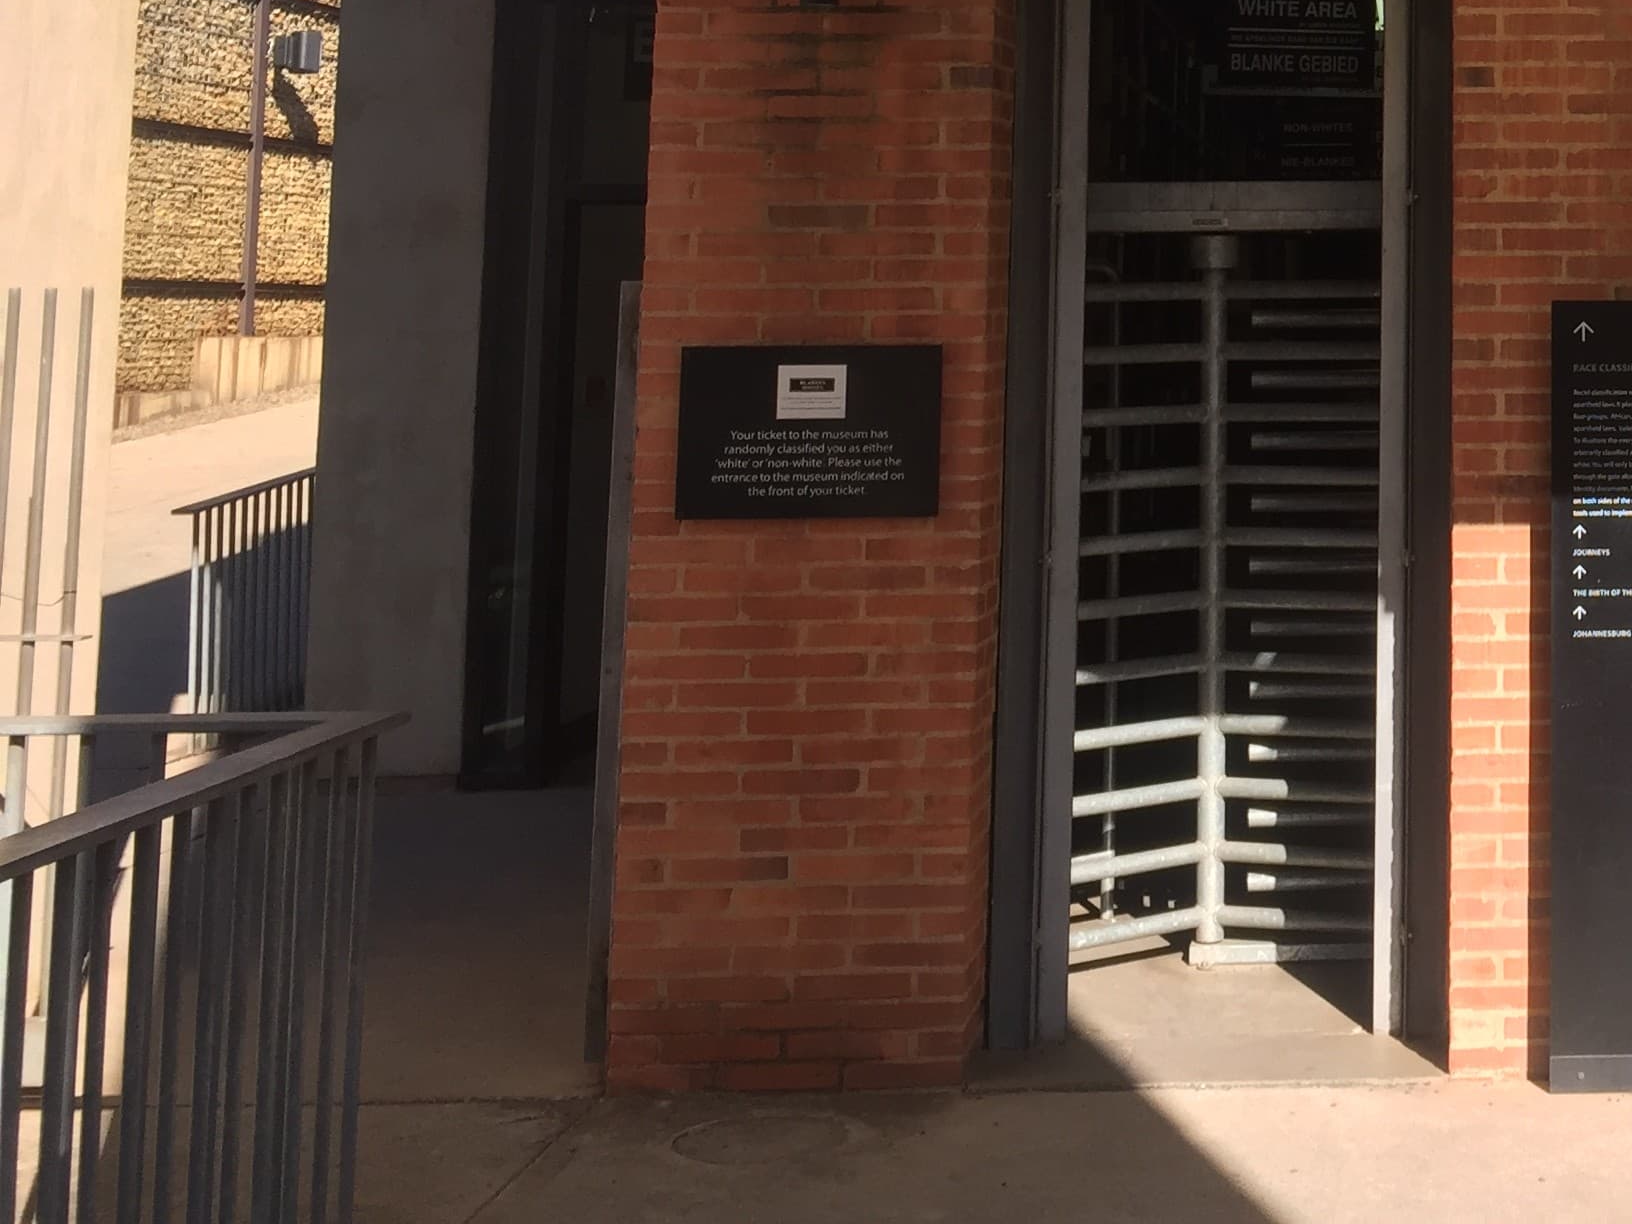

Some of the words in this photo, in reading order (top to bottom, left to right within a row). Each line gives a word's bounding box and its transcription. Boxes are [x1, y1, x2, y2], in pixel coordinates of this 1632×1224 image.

[1238, 0, 1300, 17] WHITE
[1304, 1, 1358, 18] AREA
[1231, 53, 1295, 72] BLANKE
[1299, 55, 1359, 72] GEBIED
[1573, 364, 1596, 372] RACE
[730, 430, 754, 440] Your
[758, 429, 787, 440] ticket
[789, 431, 799, 440] to
[802, 429, 819, 439] the
[822, 431, 868, 439] museum
[870, 429, 888, 439] has
[724, 444, 775, 456] randomly
[777, 443, 825, 454] classified
[827, 445, 846, 455] you
[849, 445, 860, 453] as
[862, 443, 893, 453] either
[752, 460, 763, 468] or
[828, 457, 861, 467] Please
[884, 456, 902, 466] the
[711, 474, 758, 483] entrance
[760, 474, 771, 483] to
[773, 472, 790, 482] the
[792, 474, 838, 482] museum
[840, 472, 888, 481] indicated
[747, 486, 766, 497] the
[768, 485, 794, 496] front
[797, 485, 808, 496] of
[809, 488, 833, 498] your
[1573, 548, 1610, 557] JOURNEYS
[1573, 589, 1587, 597] THE
[1589, 589, 1609, 597] BIRTH
[1611, 589, 1621, 597] OF
[1573, 629, 1631, 638] JOHANNESBURG
